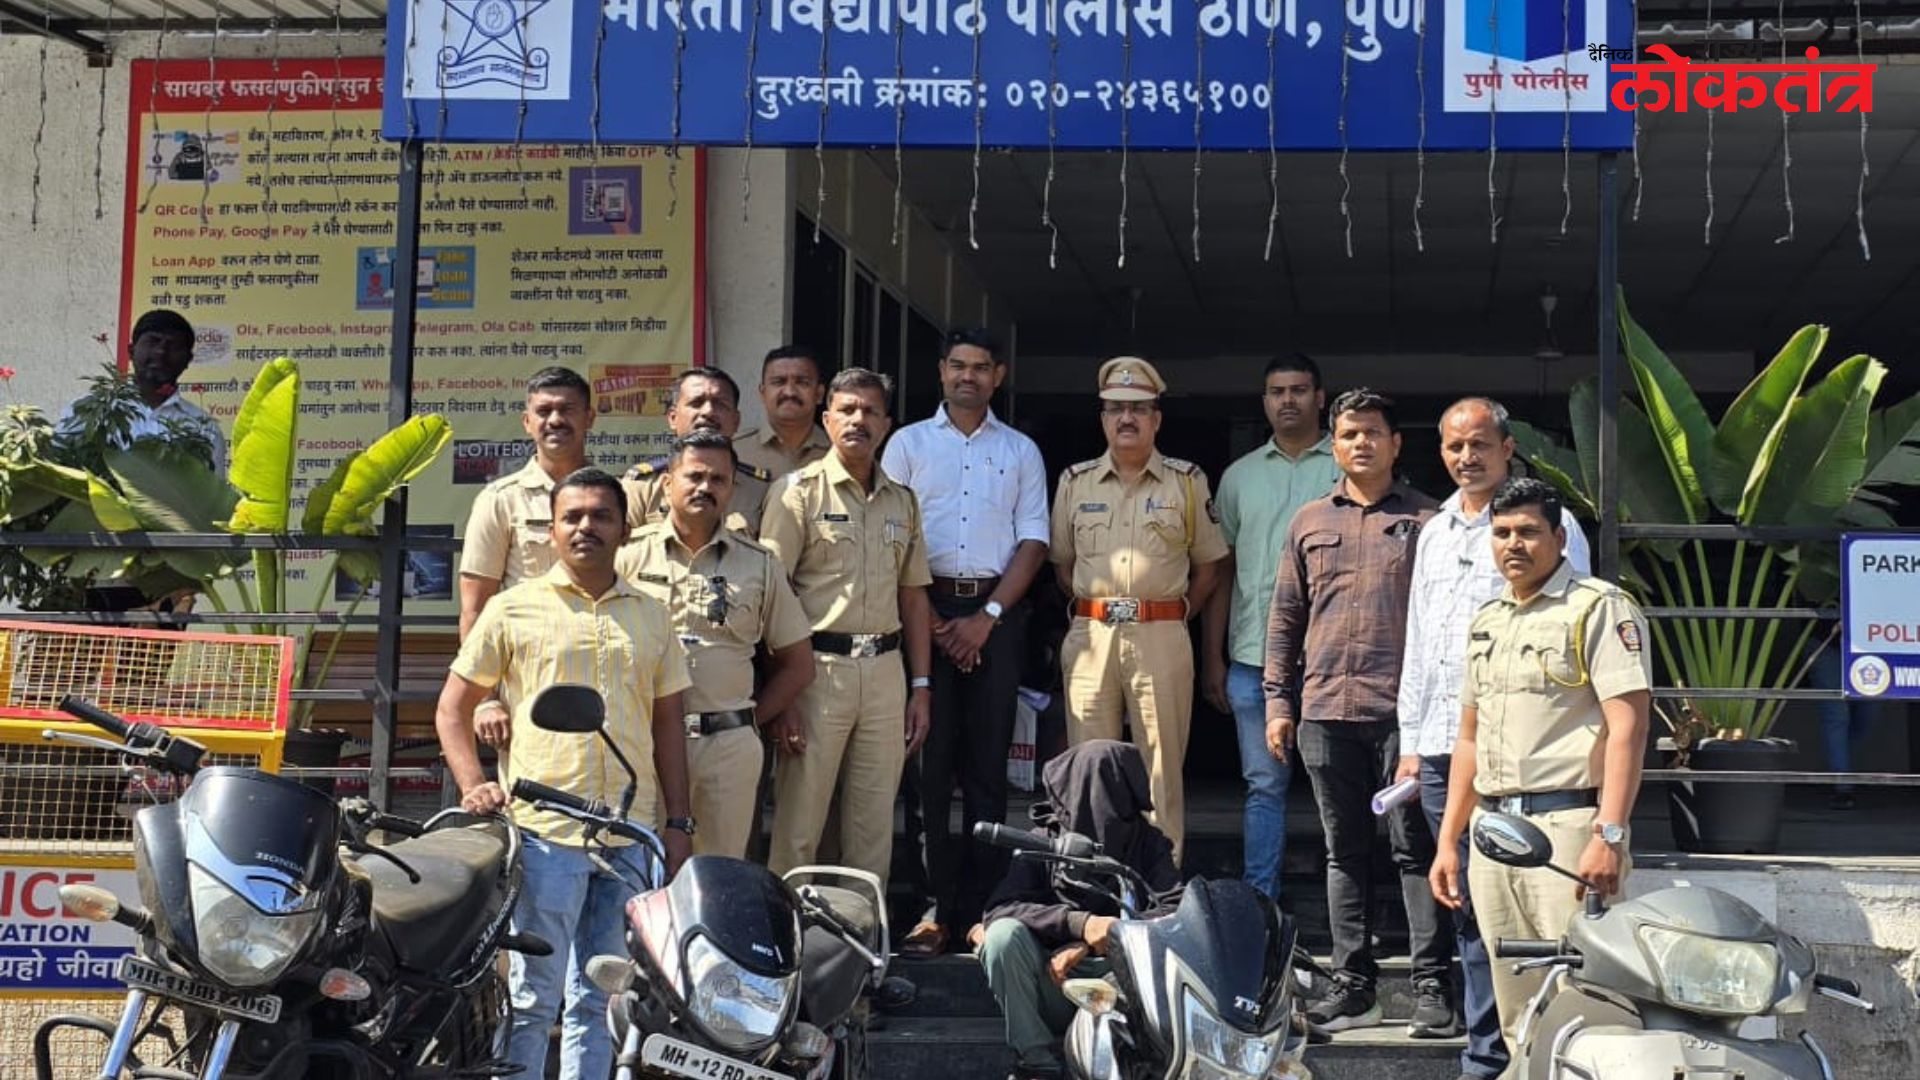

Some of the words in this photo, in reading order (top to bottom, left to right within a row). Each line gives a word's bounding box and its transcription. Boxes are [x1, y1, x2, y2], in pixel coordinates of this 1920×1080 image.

[1511, 66, 1589, 90] पोलीस
[757, 66, 864, 119] दुरध्वनी
[453, 150, 483, 161] ATM
[155, 205, 177, 216] QR
[154, 226, 195, 238] Phone
[200, 227, 226, 239] Pay,
[231, 226, 279, 240] Google
[283, 225, 307, 238] Pay
[152, 256, 185, 267] Loan
[188, 256, 216, 268] App
[267, 324, 336, 336] Facebook,
[341, 324, 392, 337] Instagr
[482, 322, 505, 333] Ola
[509, 322, 534, 333] Cab
[437, 378, 508, 391] Facebook,
[209, 404, 238, 416] Yout
[458, 442, 533, 457] LOTTERY
[254, 851, 307, 875] HONDA
[0, 923, 91, 943] ATION
[660, 1044, 689, 1067] MH
